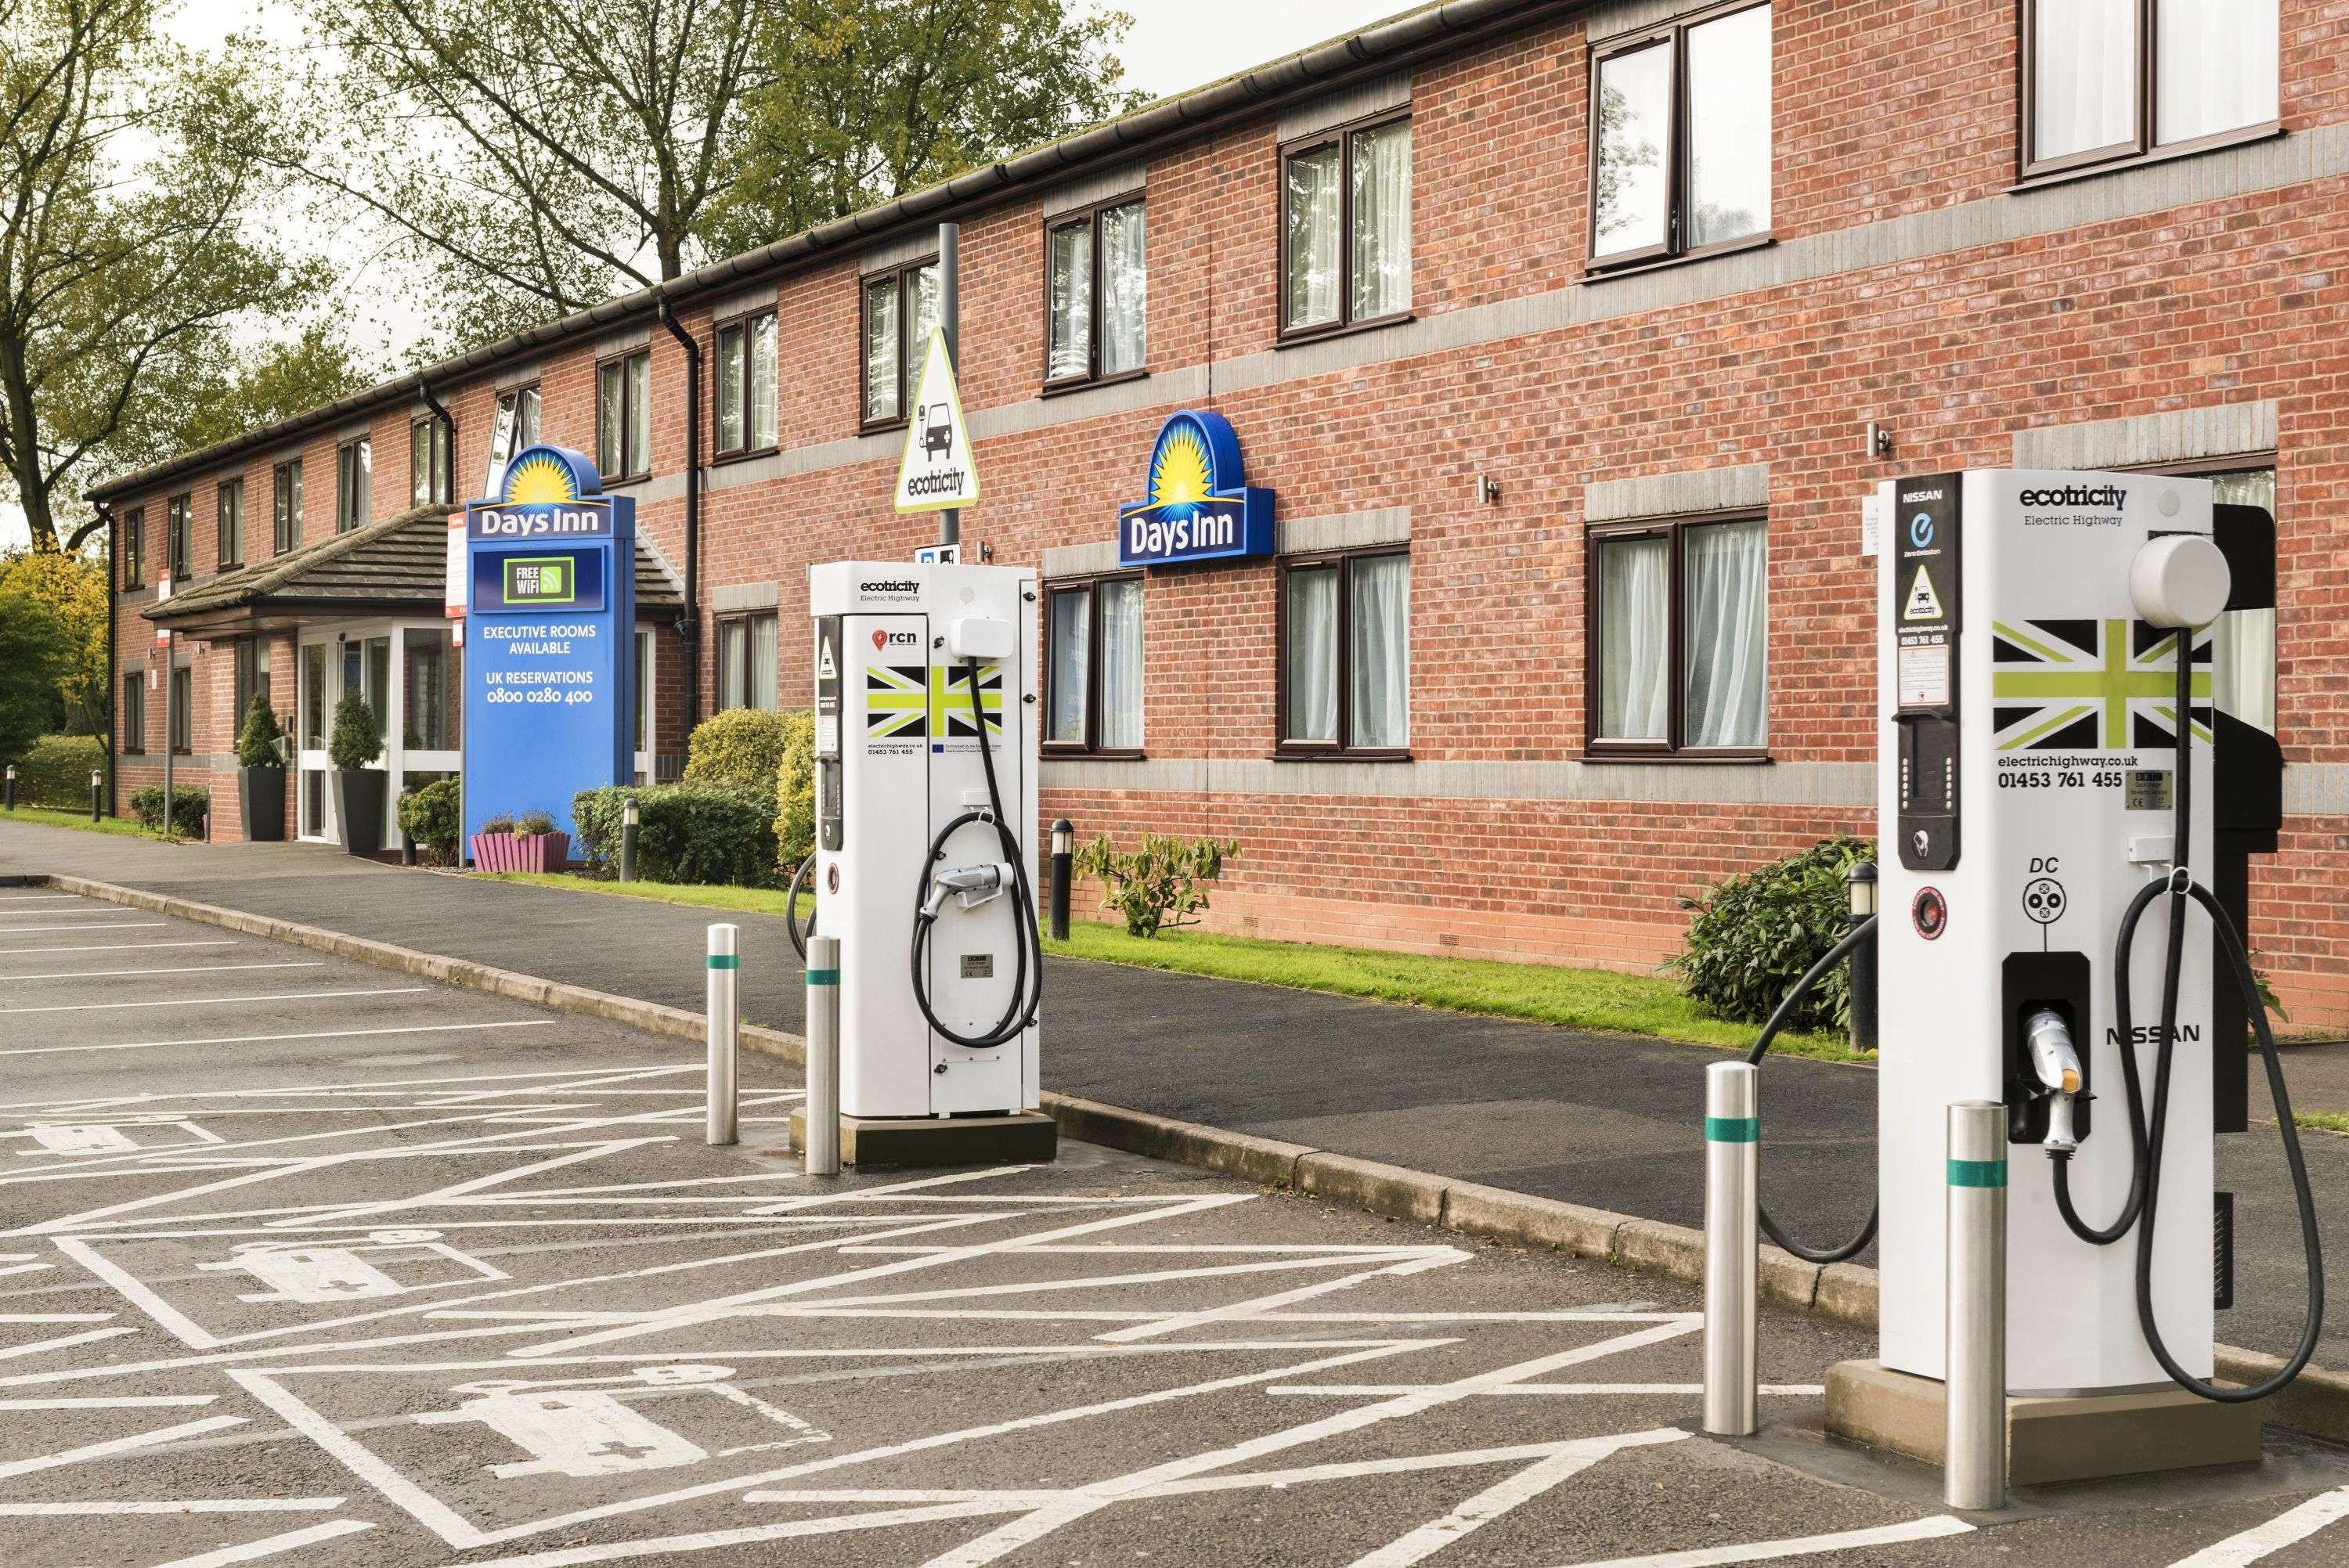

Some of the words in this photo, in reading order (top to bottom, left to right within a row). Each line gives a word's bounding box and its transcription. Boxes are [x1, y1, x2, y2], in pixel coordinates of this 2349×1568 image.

[907, 467, 965, 496] ecotricity
[1903, 489, 1942, 503] NISSAN
[2020, 485, 2127, 510] ecotricity
[482, 510, 549, 536] Days
[554, 508, 598, 532] Inn
[2025, 516, 2069, 525] Electric
[2073, 516, 2123, 527] Highway
[1131, 517, 1189, 556] Days
[1193, 510, 1233, 548] Inn
[516, 567, 539, 580] FREE
[516, 580, 539, 594] WiFi
[861, 580, 920, 593] ecotricity
[483, 626, 547, 639] EXECUTIVE
[550, 625, 596, 638] ROOMS
[889, 633, 917, 643] rcn
[509, 642, 571, 654] AVAILABLE
[486, 672, 503, 684] UK
[506, 671, 594, 684] RESERVATIONS
[487, 687, 523, 703] 0800
[526, 687, 562, 703] 0280
[565, 688, 593, 706] 400
[1997, 756, 2138, 768] electrichighway.co.uk
[1998, 773, 2051, 788] 01453
[2058, 772, 2084, 787] 761
[2092, 772, 2122, 787] 455
[2030, 857, 2059, 874] DC
[2107, 1025, 2199, 1045] NSSAN
